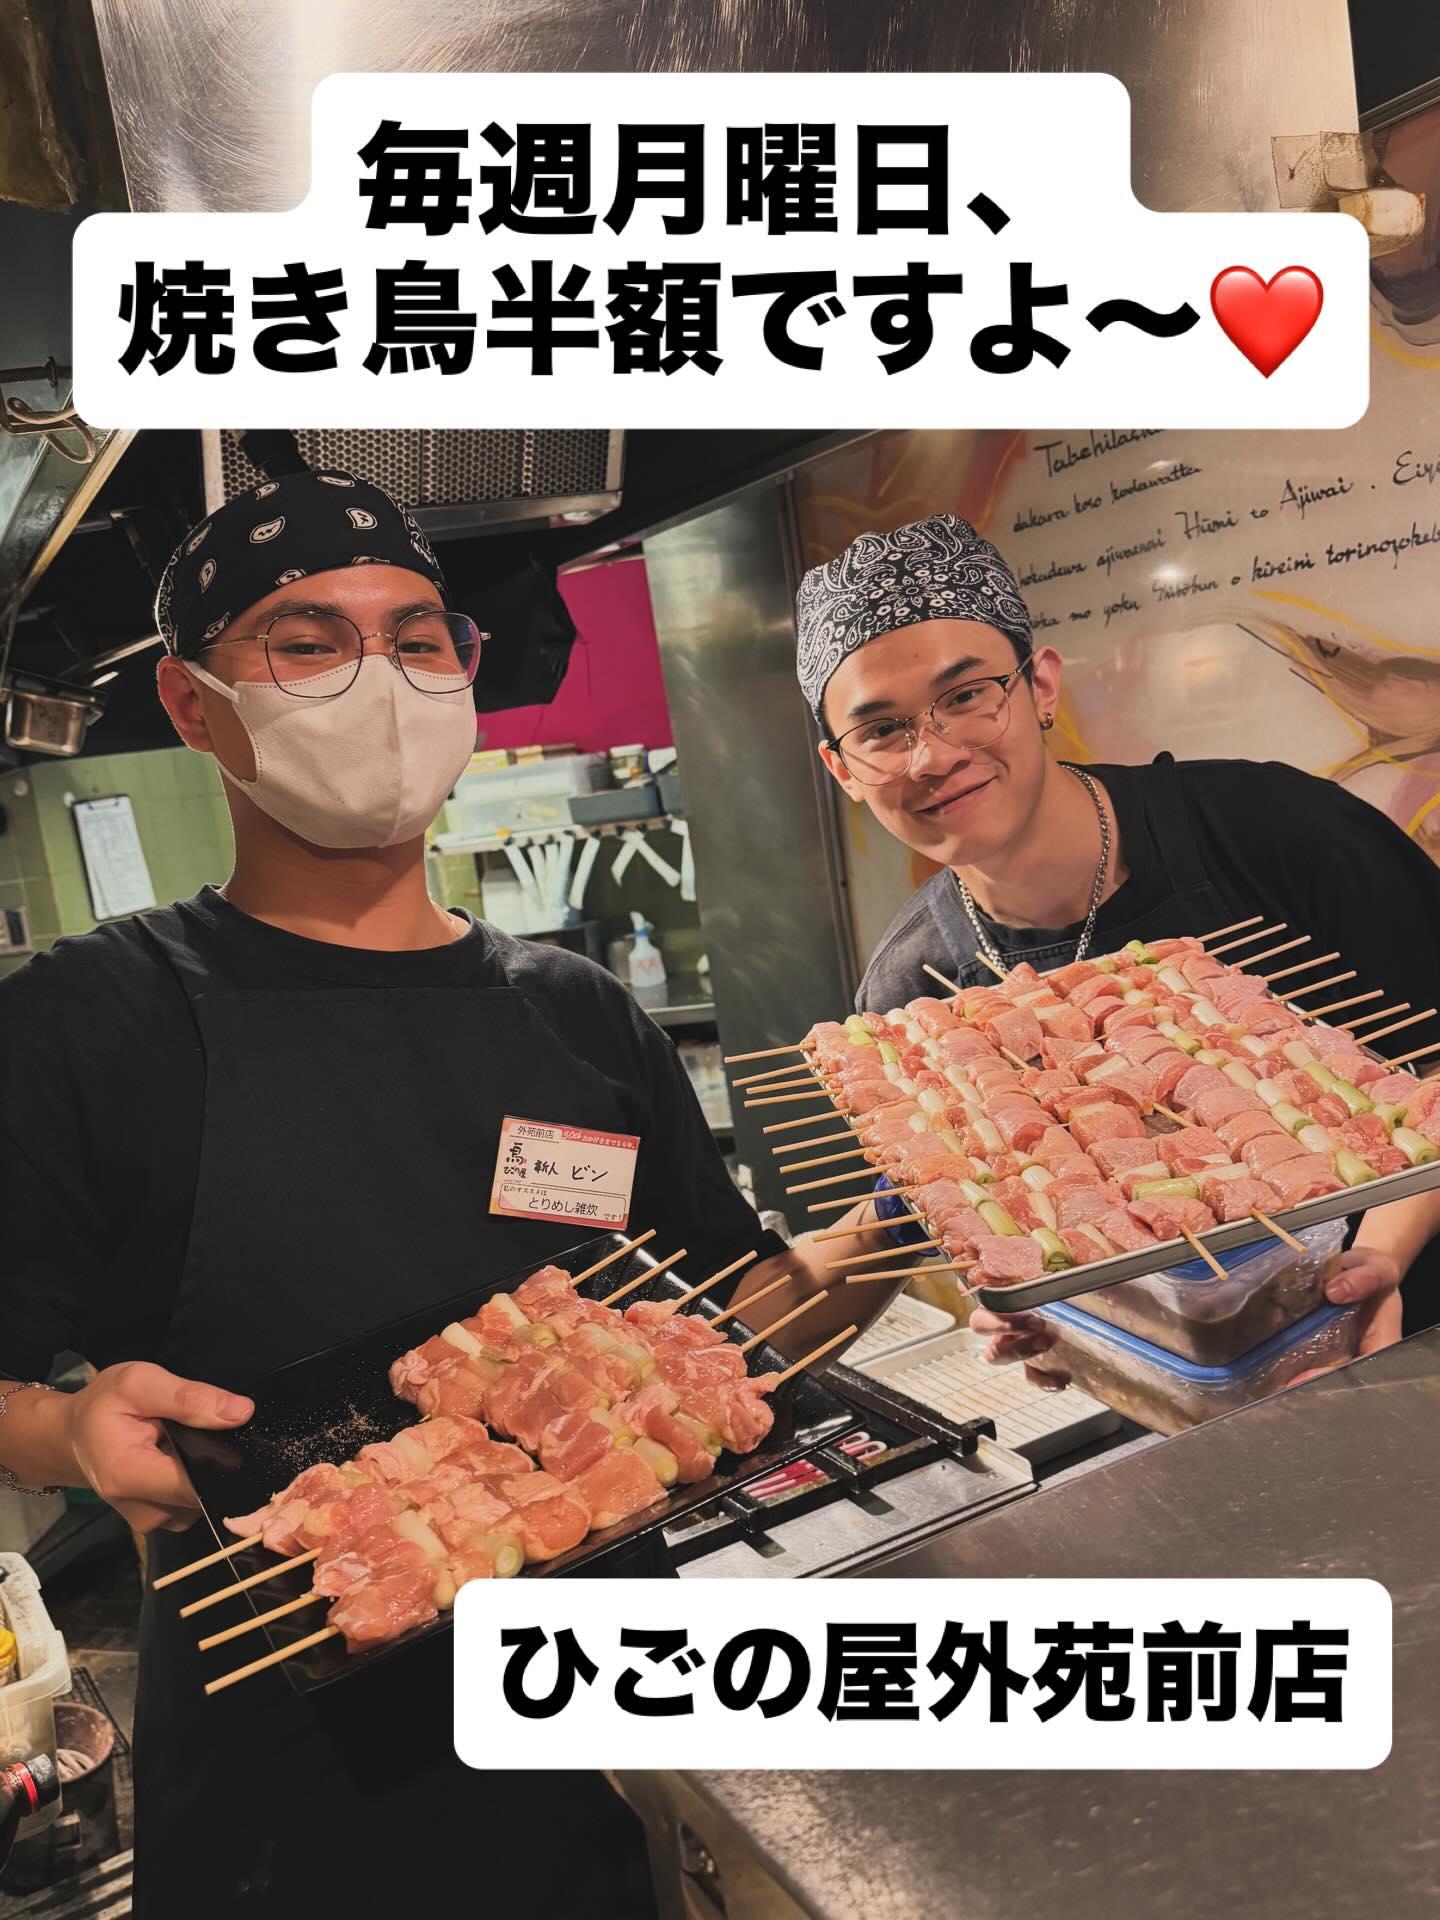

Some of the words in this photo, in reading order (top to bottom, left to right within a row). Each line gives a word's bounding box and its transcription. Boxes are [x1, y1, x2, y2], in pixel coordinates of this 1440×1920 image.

[517, 1125, 555, 1140] 外苑前店
[572, 1164, 608, 1183] ビン
[528, 1197, 599, 1217] とりめし雑炊
